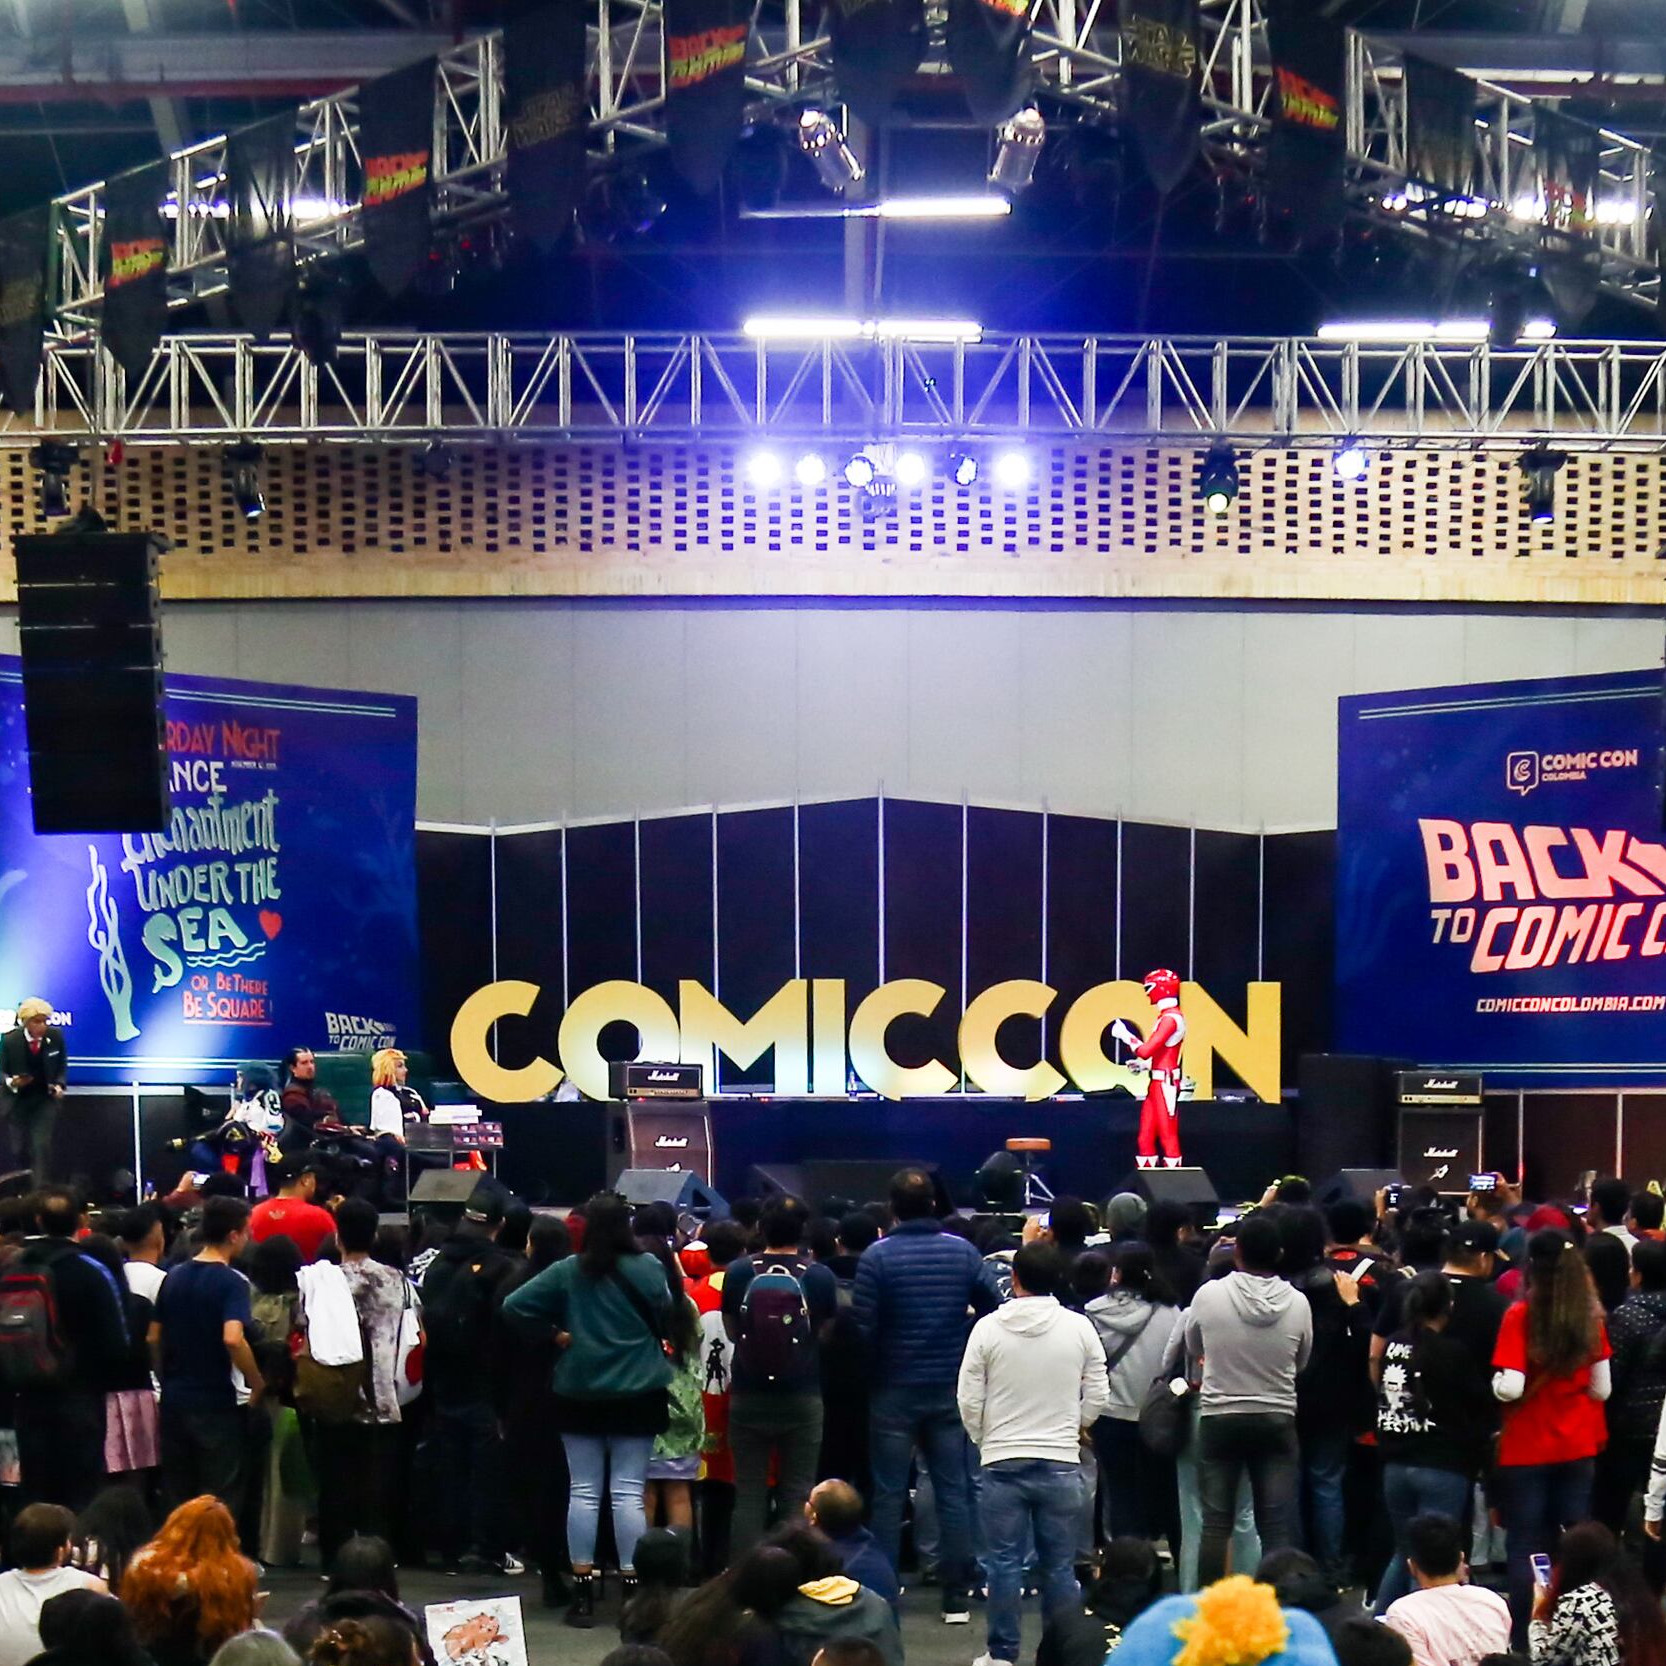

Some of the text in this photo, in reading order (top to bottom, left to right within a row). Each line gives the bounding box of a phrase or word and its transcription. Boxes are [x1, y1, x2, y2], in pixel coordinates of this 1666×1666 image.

[164, 720, 281, 759] RDAY NIGHT
[169, 760, 227, 792] NCE
[1542, 749, 1638, 771] COMIC CON
[1418, 819, 1666, 903] BACK
[120, 857, 282, 911] UNDER THE
[142, 907, 248, 994] SEA
[1430, 909, 1475, 943] TO
[1470, 902, 1644, 973] COMIC
[45, 1012, 72, 1025] ON
[1476, 996, 1666, 1014] COMICCONCOLOMBIA.COM
[325, 1011, 381, 1035] BACK
[339, 1035, 377, 1052] COMIC
